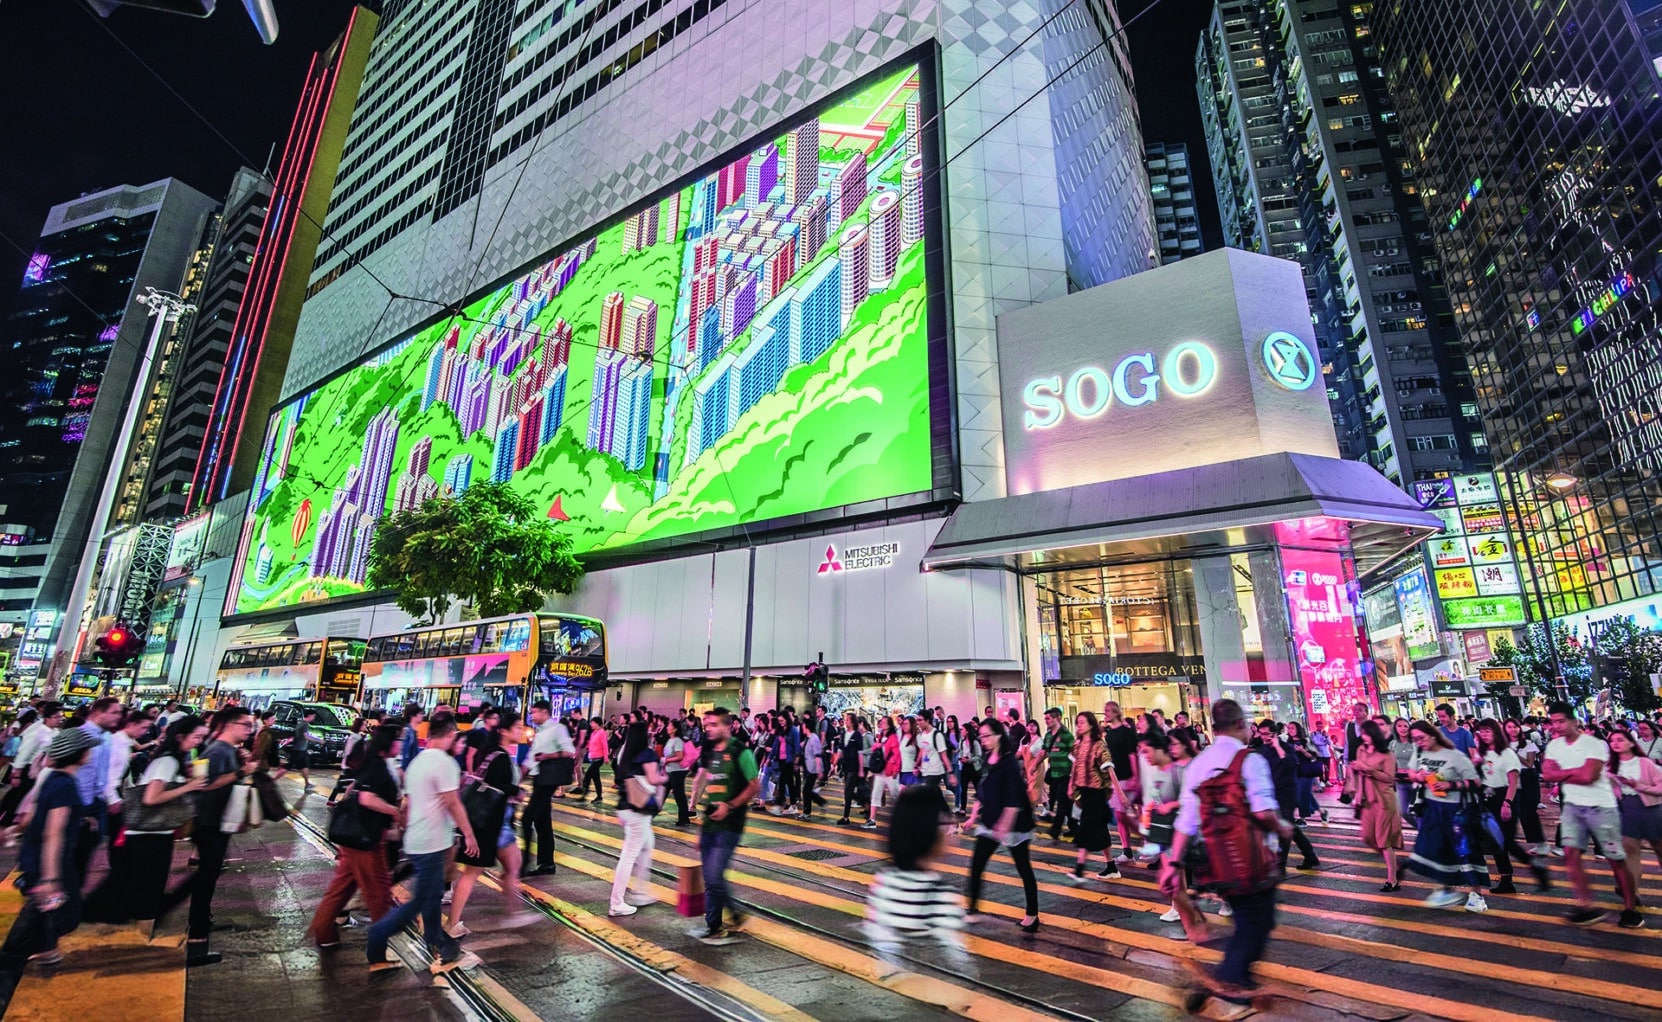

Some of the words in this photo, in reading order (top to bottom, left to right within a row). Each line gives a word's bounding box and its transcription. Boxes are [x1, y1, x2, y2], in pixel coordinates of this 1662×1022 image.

[1023, 341, 1217, 428] SOGO
[845, 543, 898, 559] MITSUBISHI
[845, 556, 891, 570] ELECTRIC
[1116, 665, 1177, 677] BOTTEGA
[1094, 673, 1131, 685] SOGO
